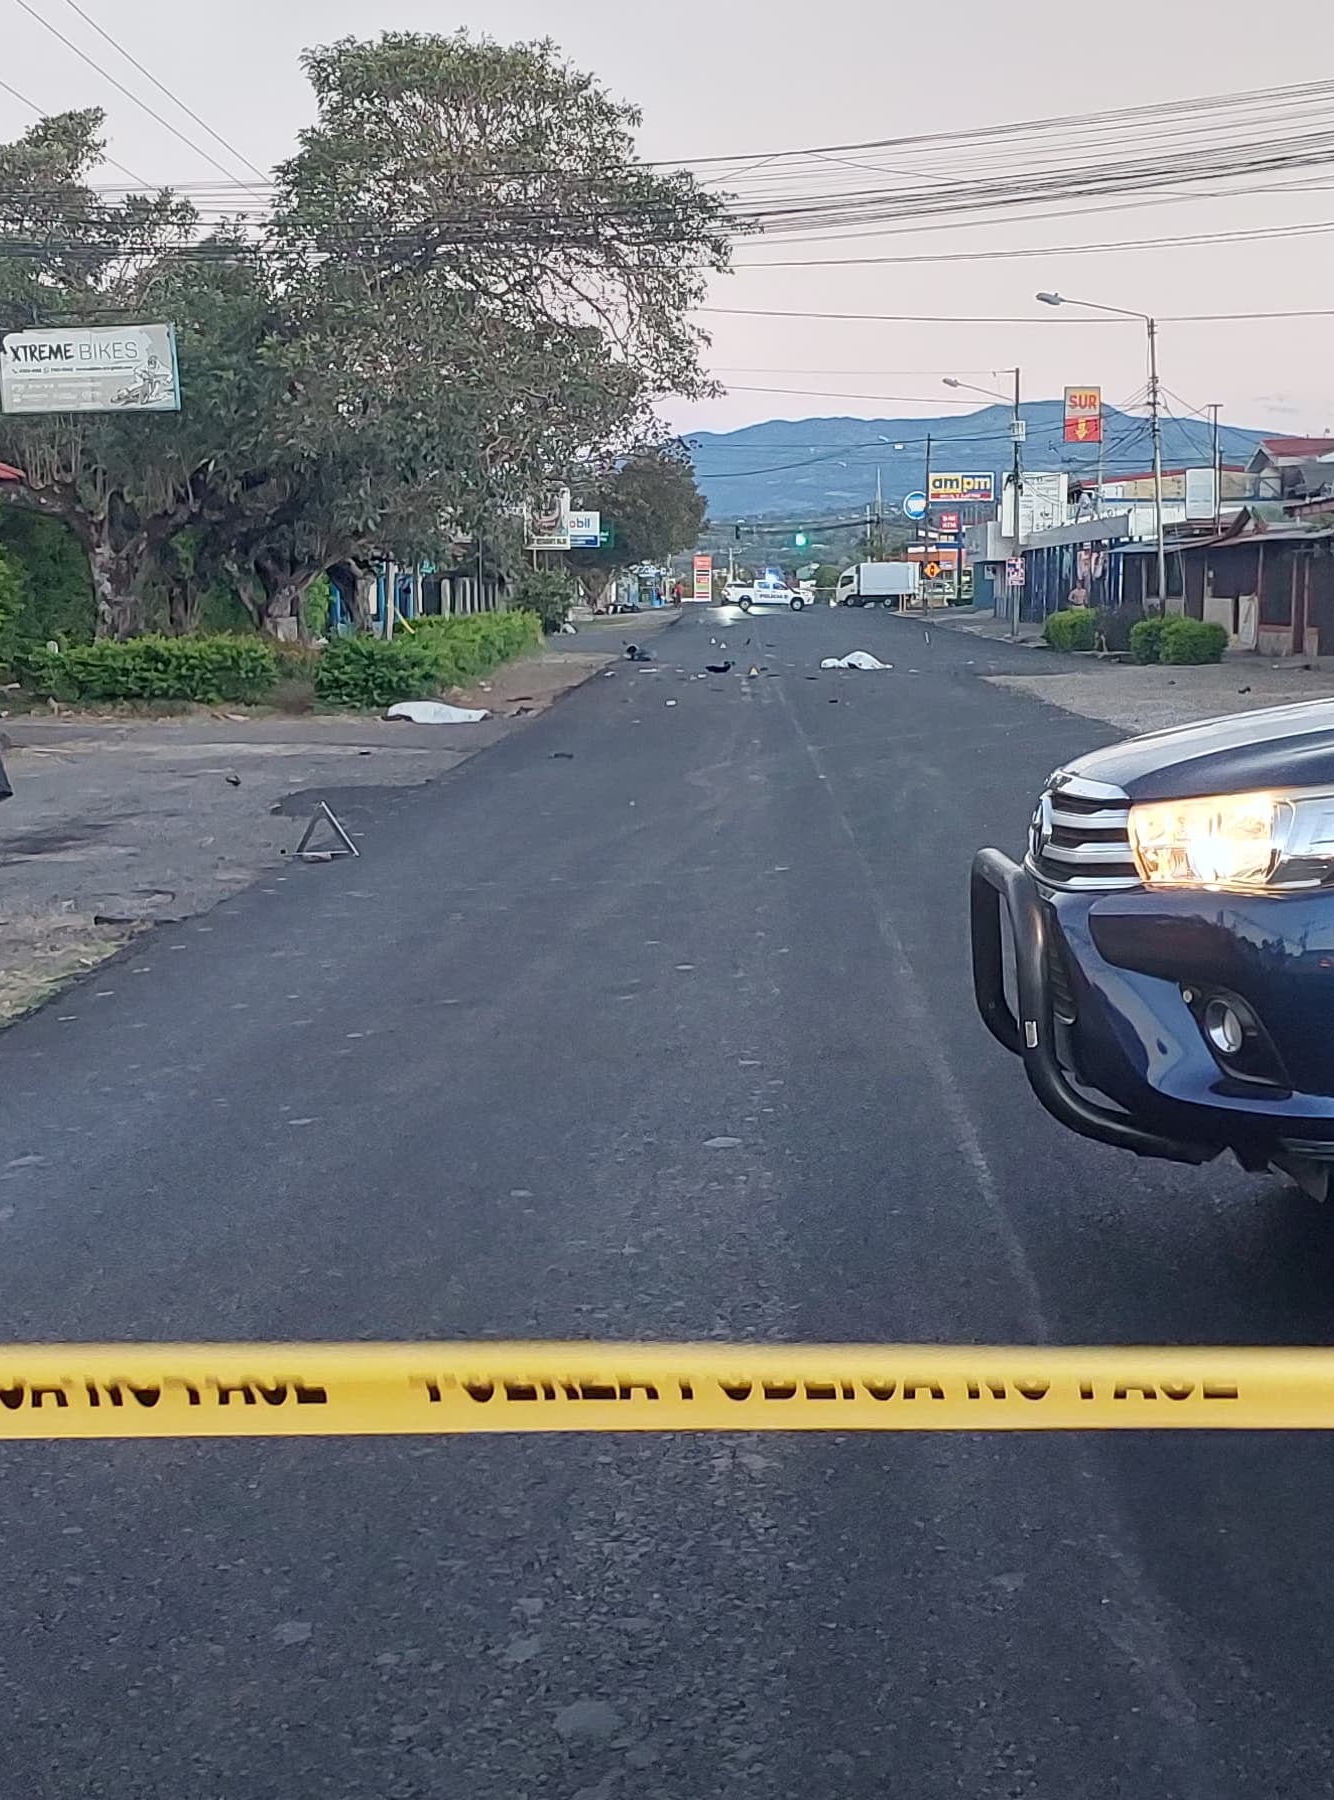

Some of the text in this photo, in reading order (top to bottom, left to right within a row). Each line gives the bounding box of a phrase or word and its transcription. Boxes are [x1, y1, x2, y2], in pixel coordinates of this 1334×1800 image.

[9, 341, 138, 362] XTREME BIKES
[1068, 394, 1097, 410] SUR
[569, 518, 591, 529] obil
